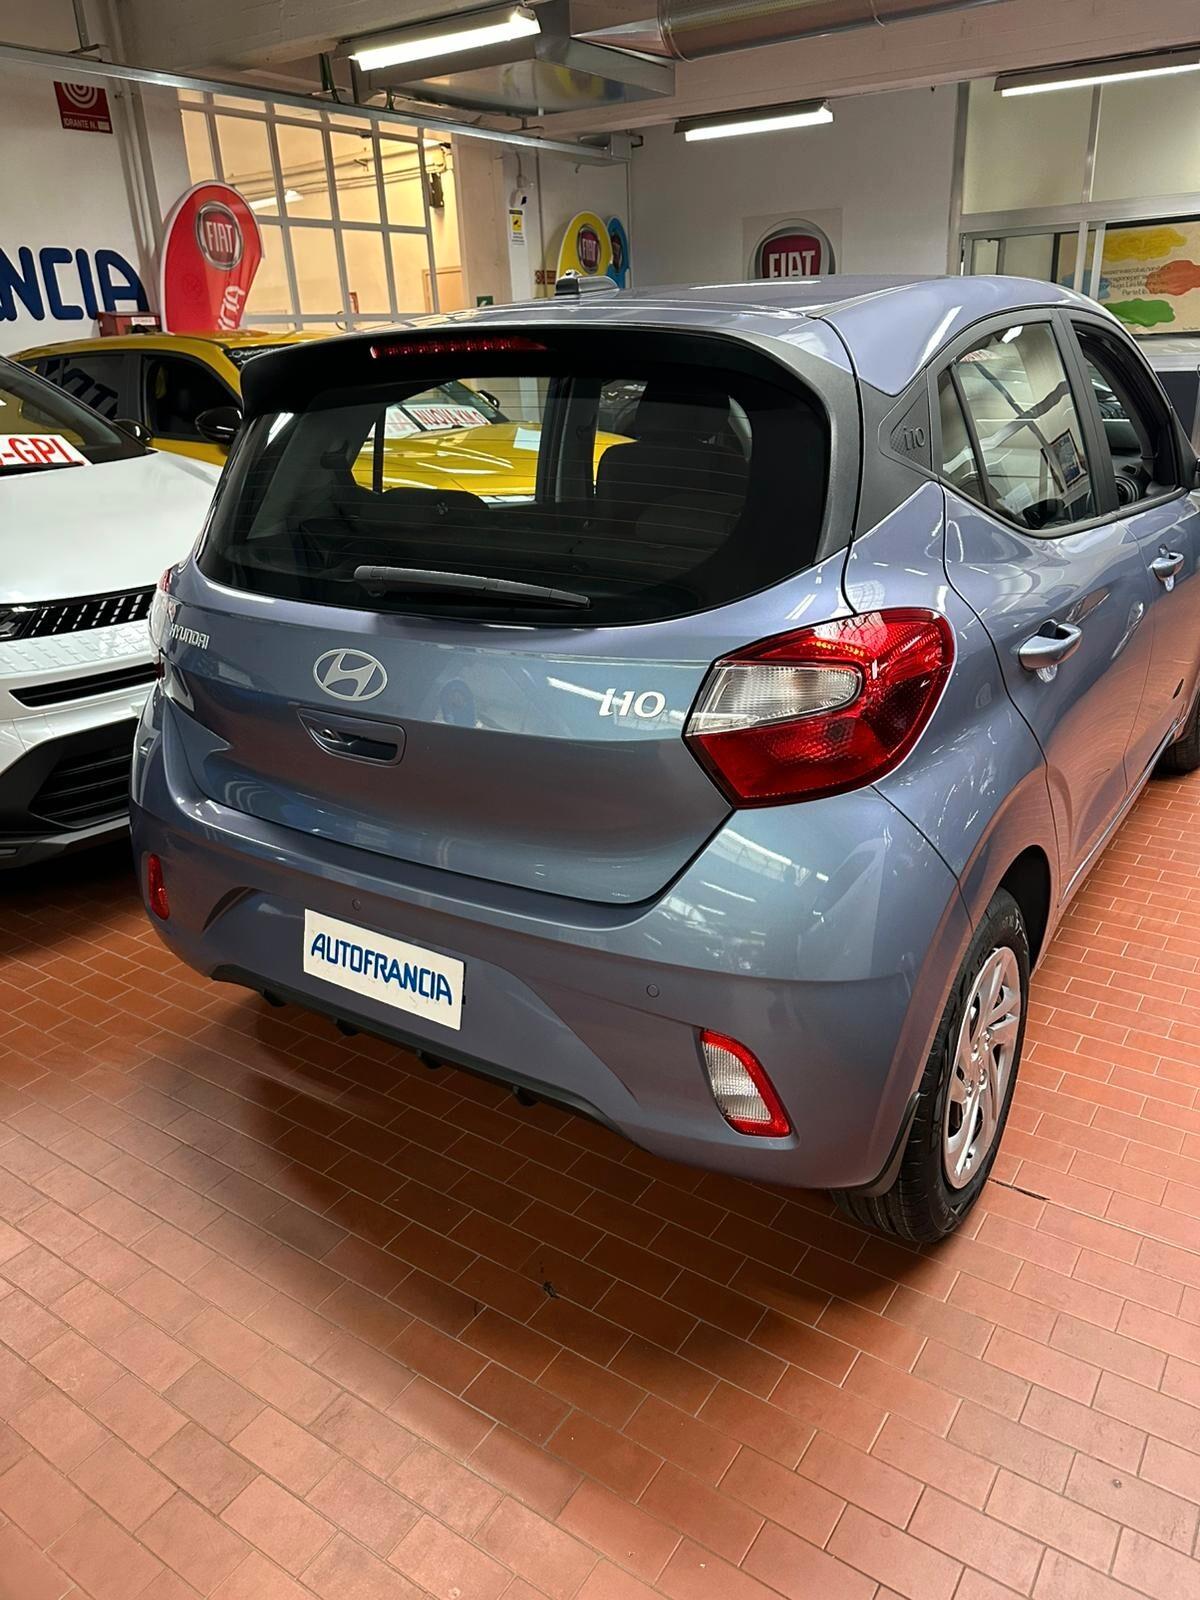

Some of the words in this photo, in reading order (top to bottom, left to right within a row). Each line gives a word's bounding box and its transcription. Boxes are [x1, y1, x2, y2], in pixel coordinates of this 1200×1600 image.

[63, 117, 89, 129] IDRANTE
[205, 221, 233, 253] FIAT
[582, 238, 597, 261] FIAT
[768, 250, 816, 278] FIAT
[168, 623, 210, 650] HYUNDAI
[598, 687, 666, 719] i10
[310, 933, 453, 1006] AUTOFRANCIA
